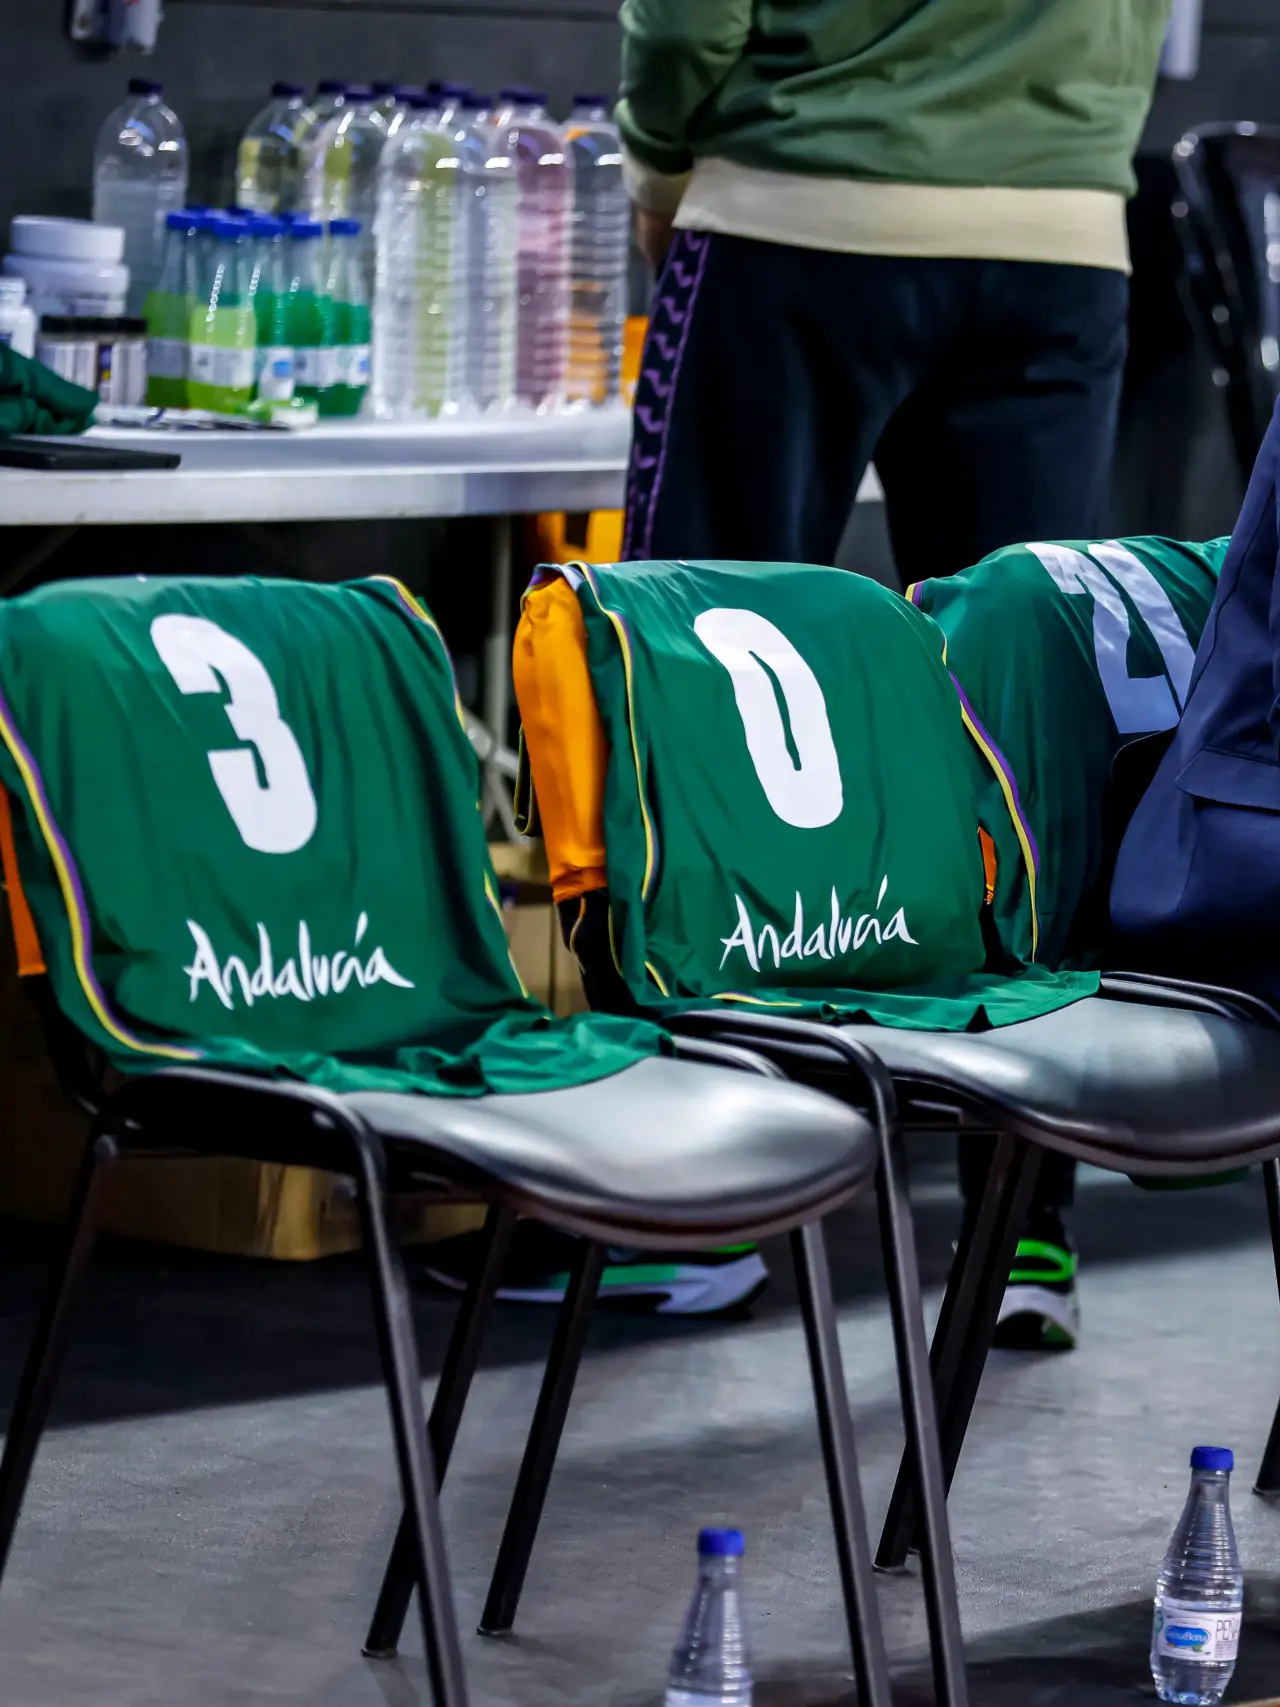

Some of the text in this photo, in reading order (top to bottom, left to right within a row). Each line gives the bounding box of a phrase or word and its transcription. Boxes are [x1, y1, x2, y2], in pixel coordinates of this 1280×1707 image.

[150, 613, 317, 853] 3
[693, 607, 843, 828] 0
[182, 911, 416, 1010] Andalucía
[718, 874, 920, 973] Andalucía
